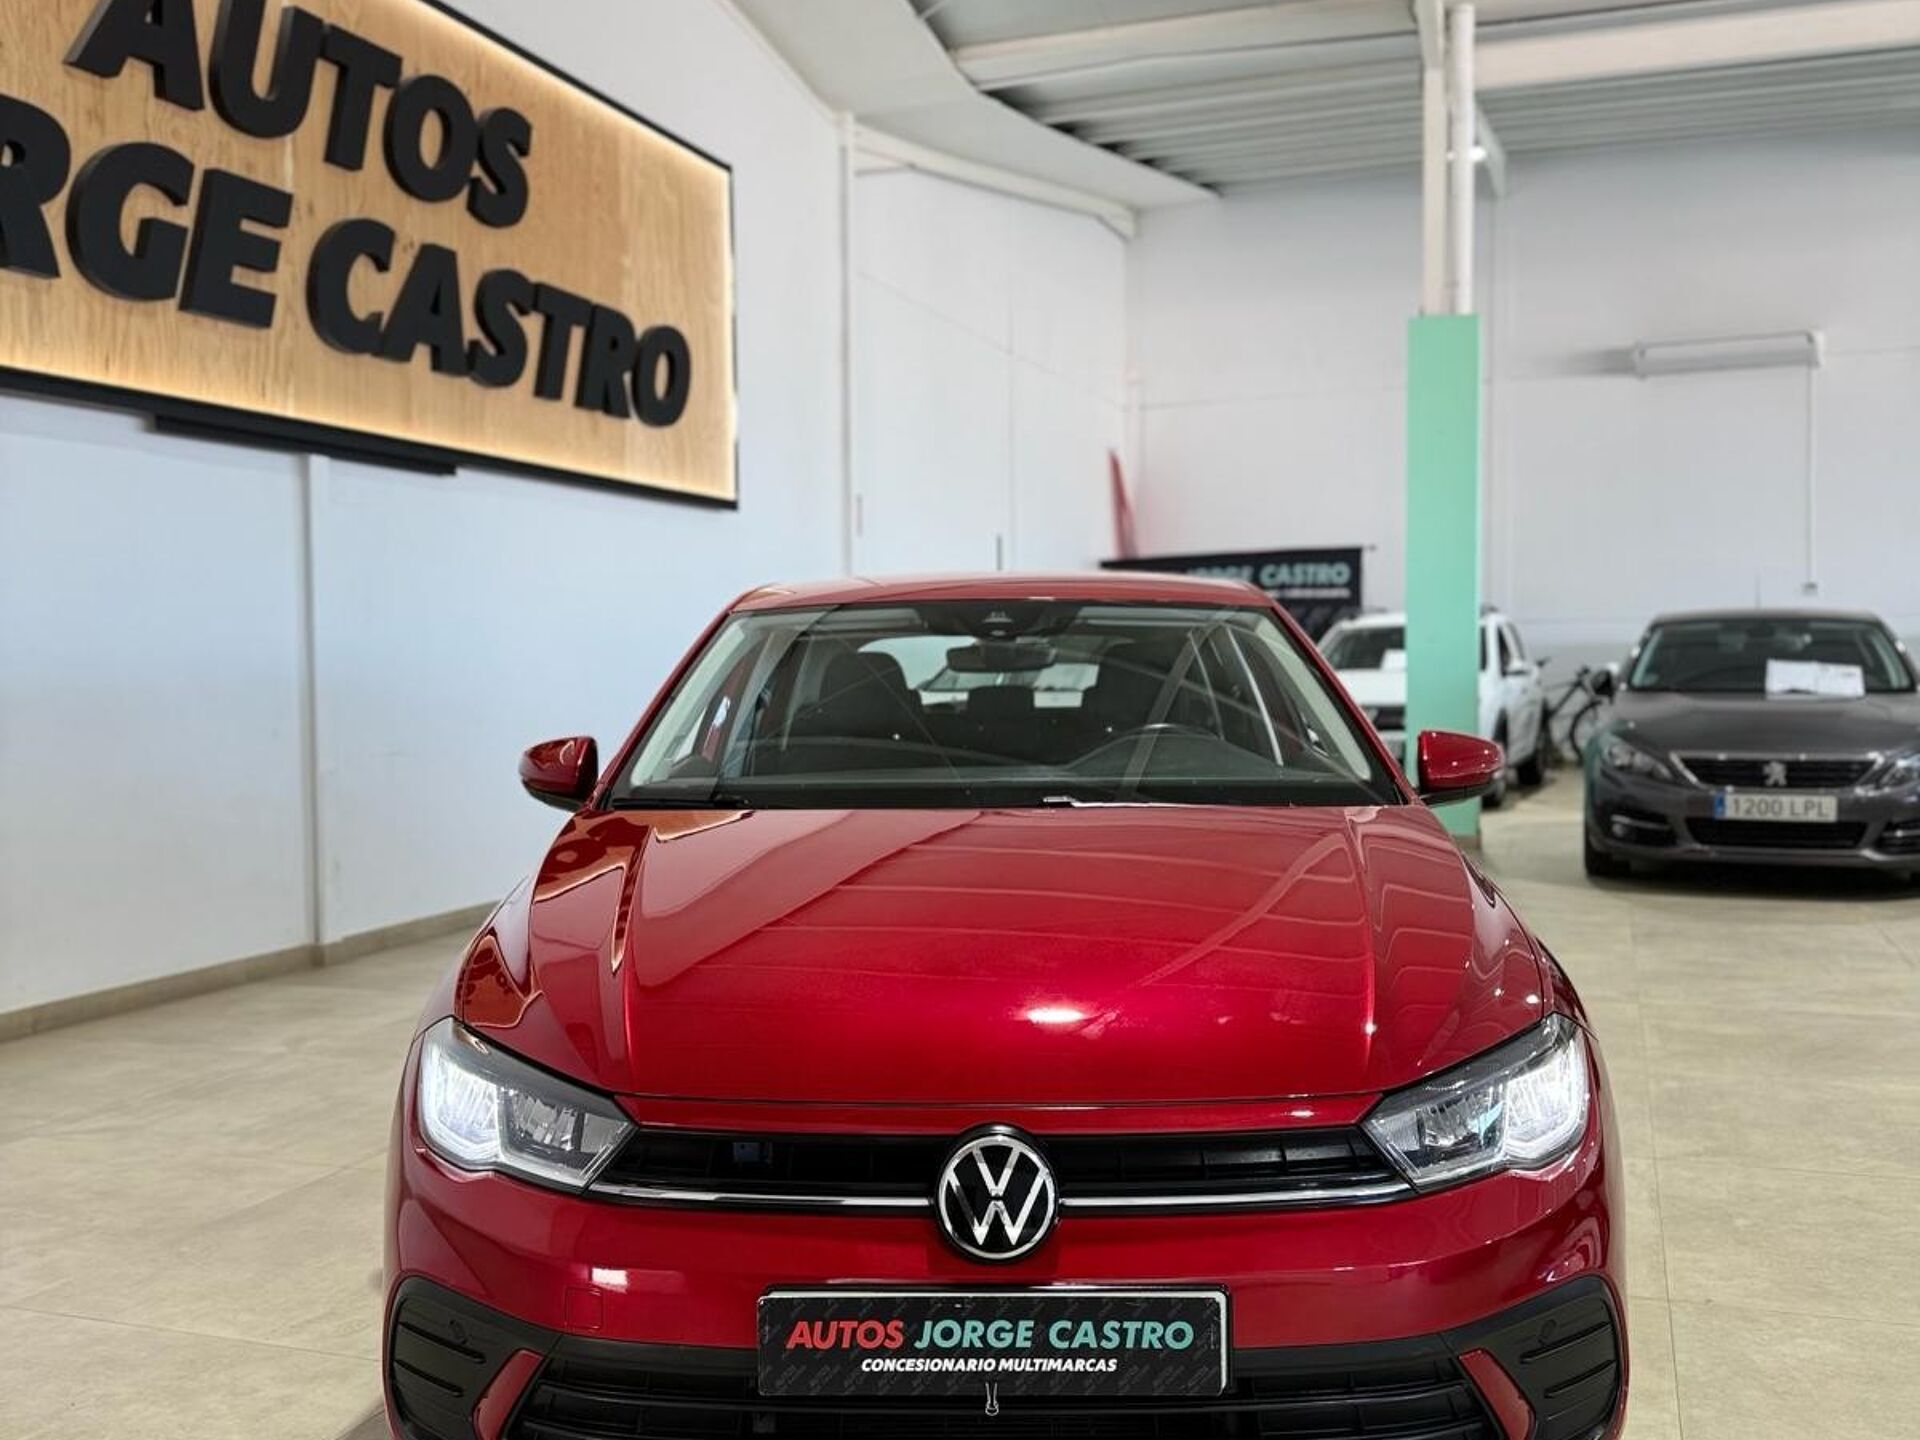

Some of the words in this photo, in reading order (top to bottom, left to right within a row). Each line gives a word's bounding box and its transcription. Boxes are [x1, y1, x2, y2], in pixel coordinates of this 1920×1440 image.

[63, 0, 532, 229] AUTOS
[306, 218, 691, 428] CASTRO
[1259, 562, 1351, 587] CASTRO
[1733, 798, 1783, 817] 1200
[1790, 799, 1831, 818] LPL
[786, 1320, 904, 1350] AUTOS
[914, 1320, 1035, 1350] JORGE
[1048, 1320, 1195, 1350] CASTRO
[861, 1358, 996, 1372] CONCESIONARIO
[998, 1358, 1118, 1372] MULTIMARCAS
